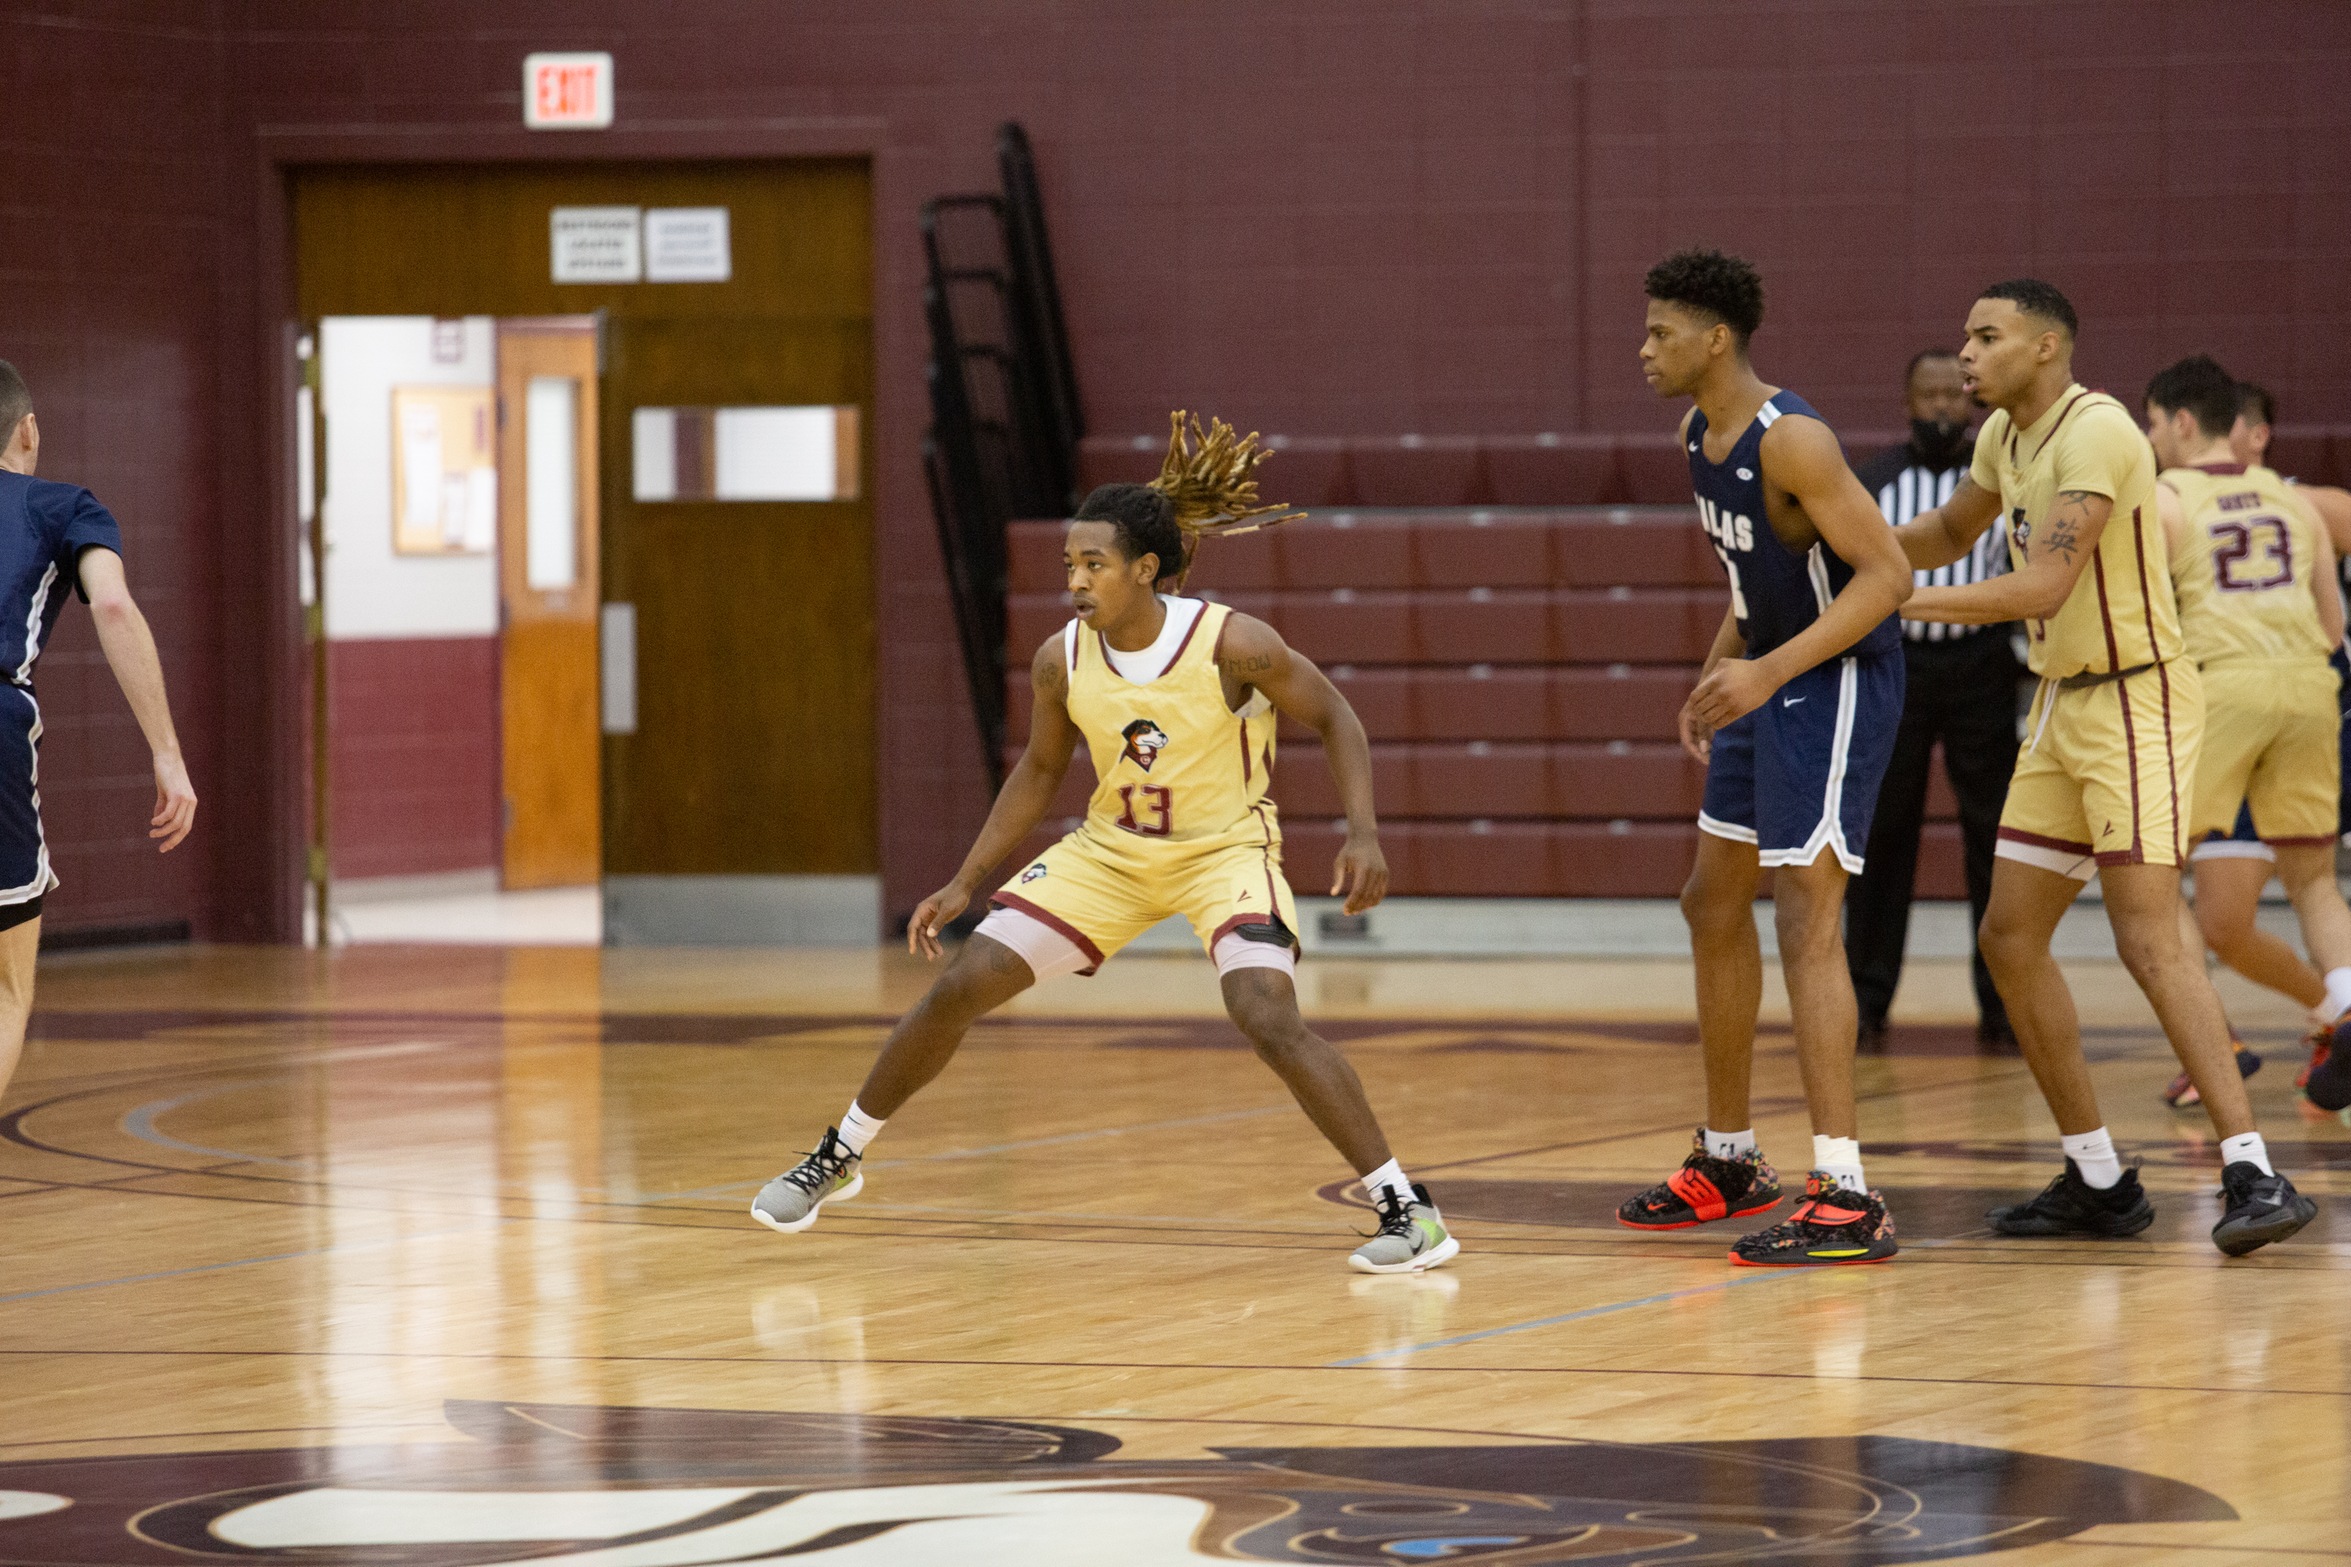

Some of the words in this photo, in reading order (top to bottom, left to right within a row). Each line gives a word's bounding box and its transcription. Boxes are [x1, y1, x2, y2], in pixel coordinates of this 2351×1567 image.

[537, 66, 598, 120] EXIT
[2207, 516, 2294, 592] 23
[1115, 783, 1173, 838] 13
